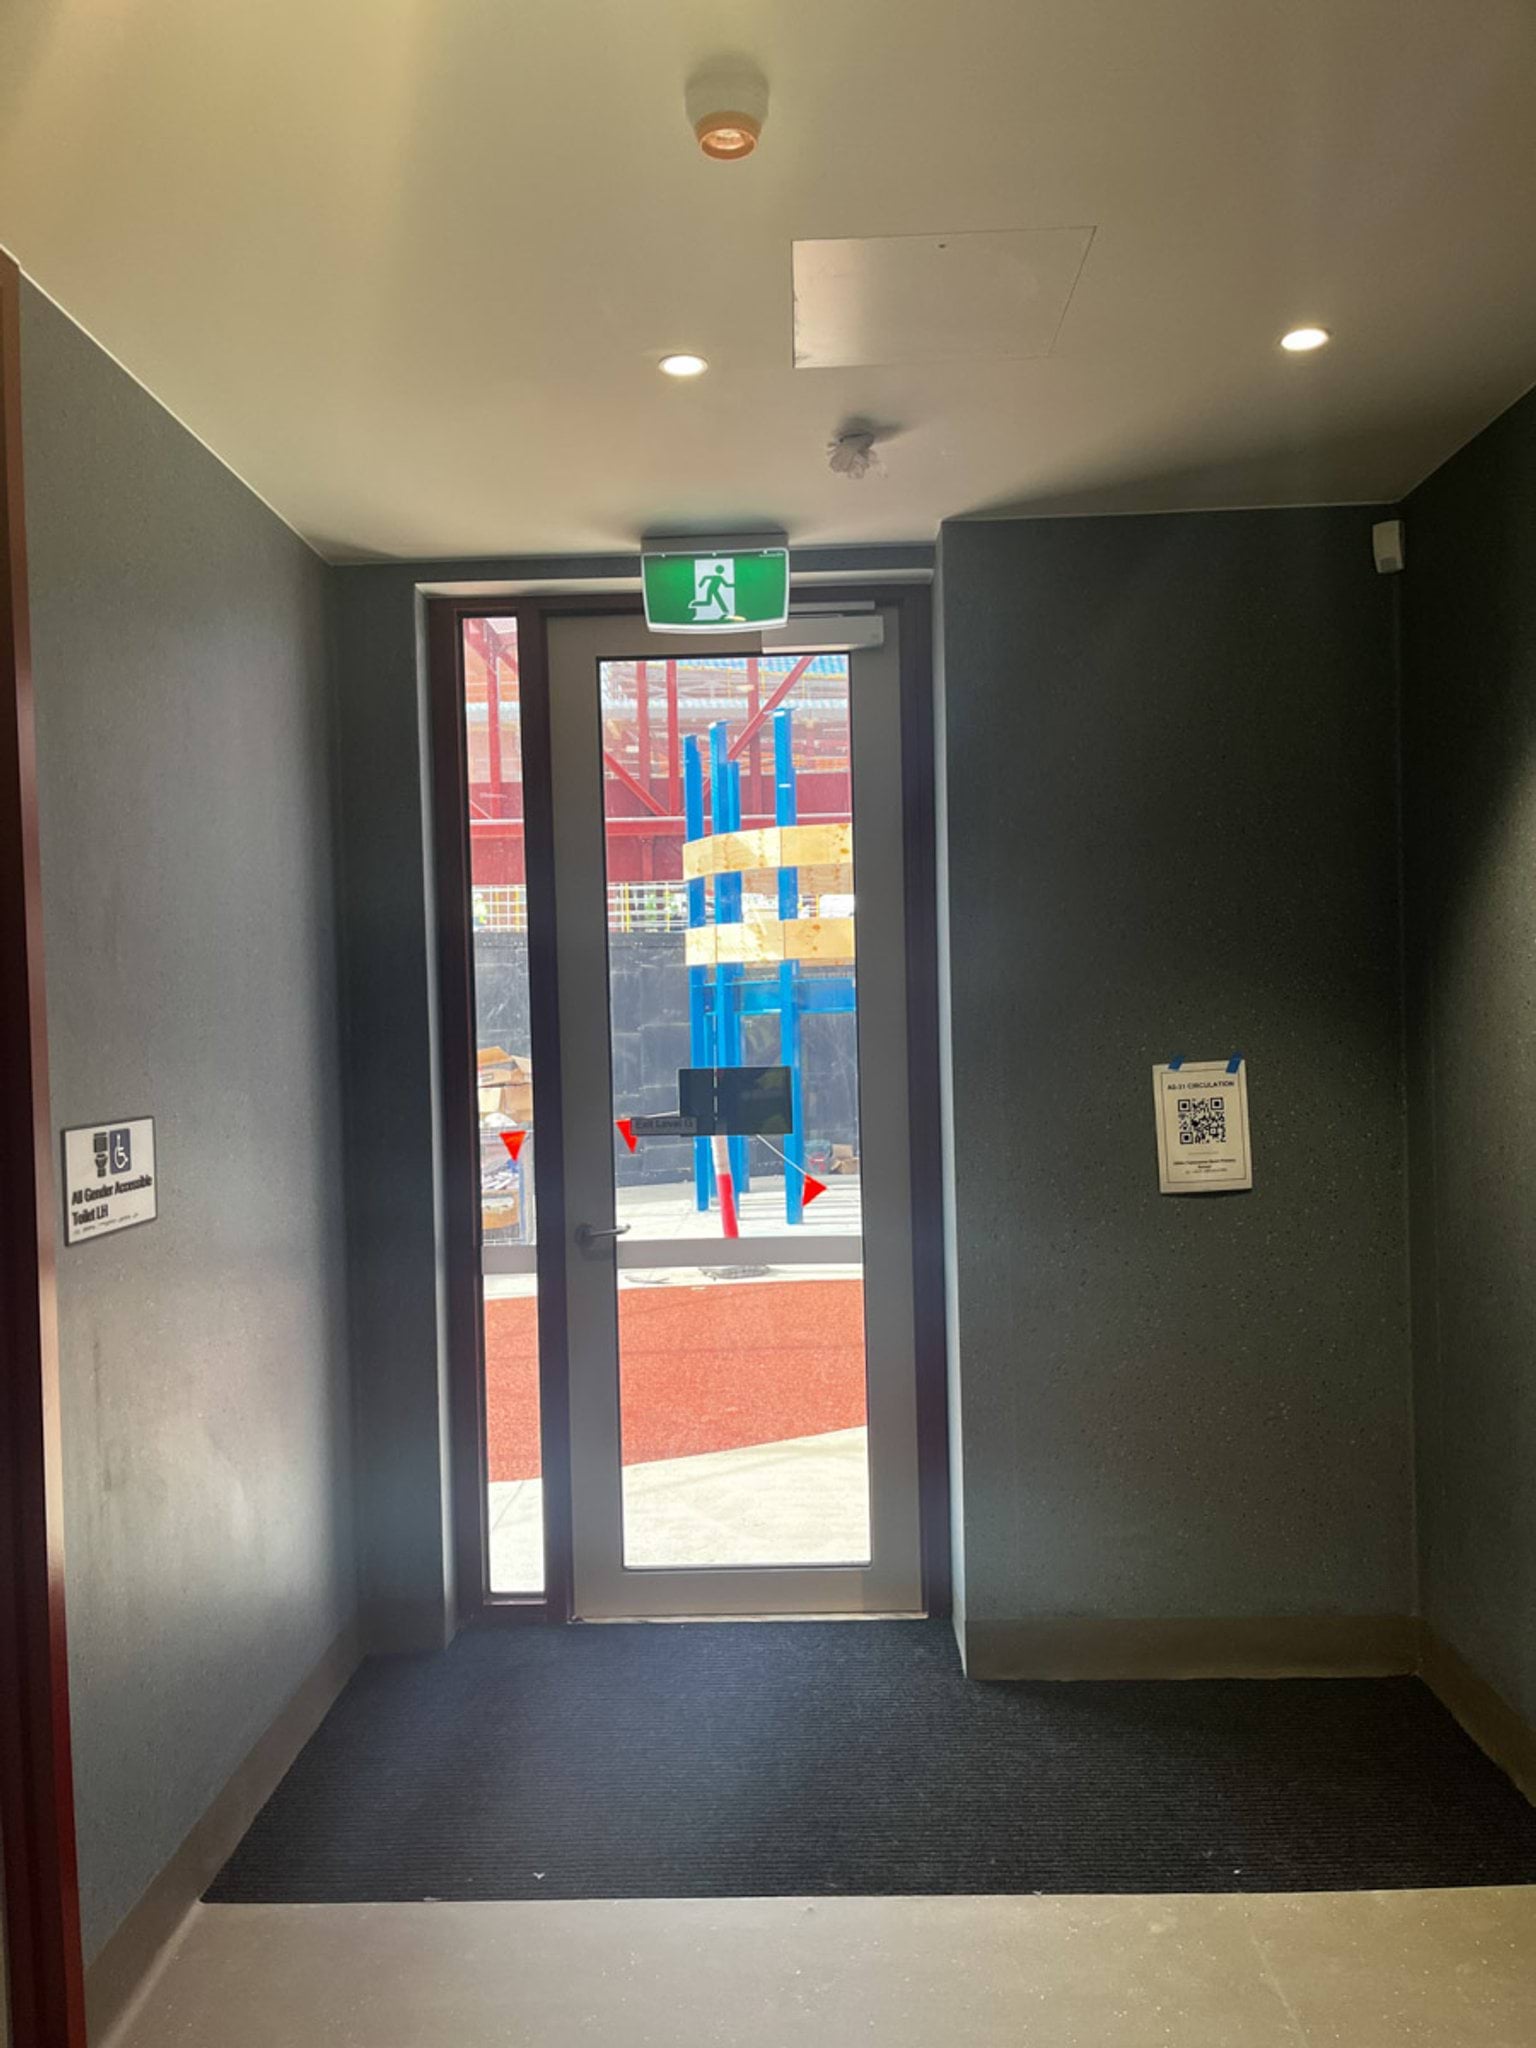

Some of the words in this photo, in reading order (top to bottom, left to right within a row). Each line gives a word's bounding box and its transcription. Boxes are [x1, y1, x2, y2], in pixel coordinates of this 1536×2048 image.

[1187, 1081, 1235, 1089] CIRCULATION
[72, 1190, 83, 1205] All
[85, 1184, 113, 1202] Gender
[115, 1175, 152, 1195] Accessible
[72, 1208, 95, 1226] Toilet
[96, 1204, 108, 1220] LH
